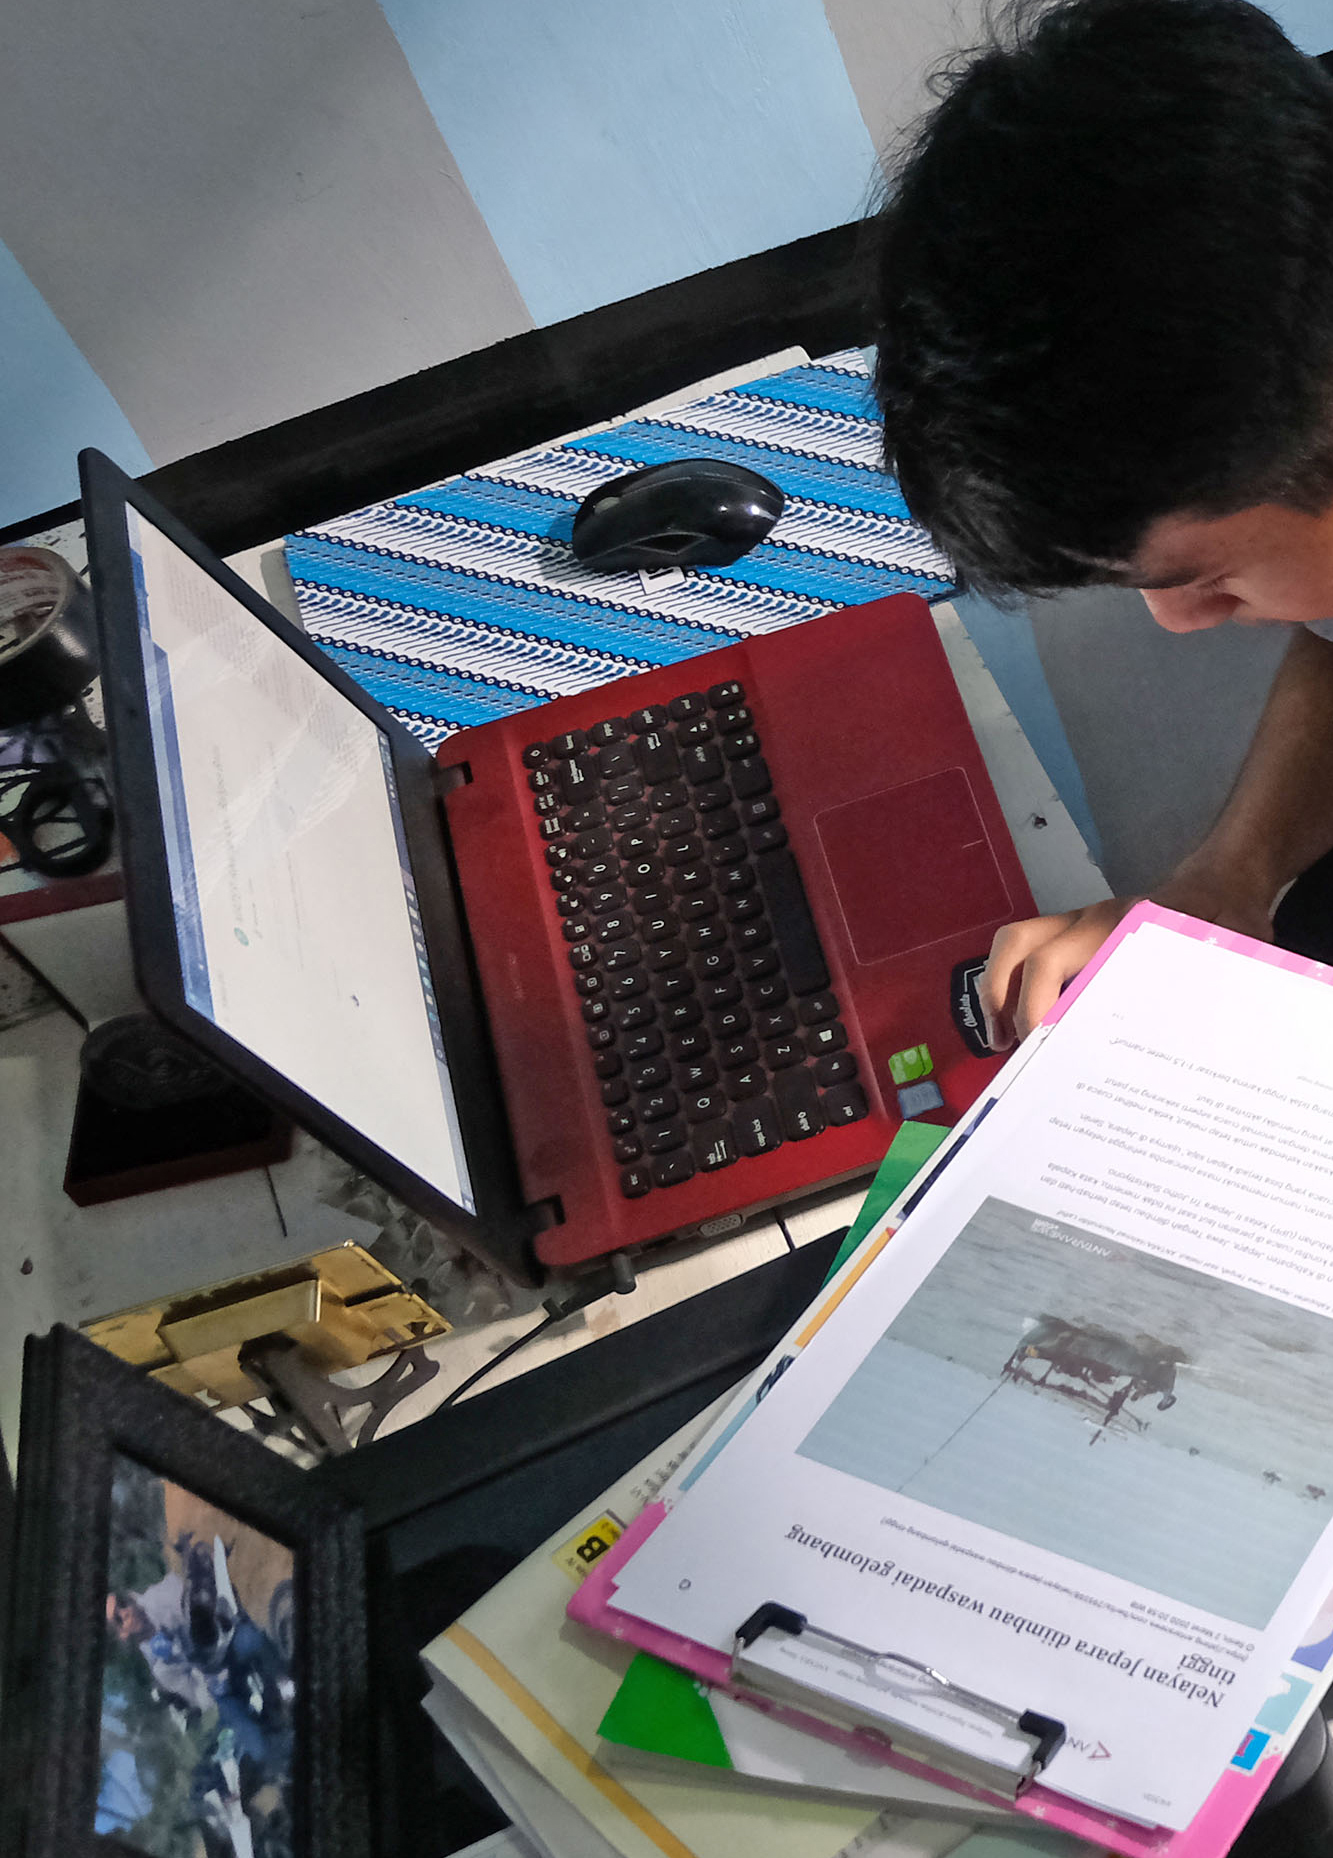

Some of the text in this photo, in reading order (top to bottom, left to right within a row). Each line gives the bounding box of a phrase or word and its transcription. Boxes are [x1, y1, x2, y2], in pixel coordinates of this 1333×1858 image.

[577, 1534, 610, 1563] B
[784, 1524, 895, 1576] gelombang
[891, 1570, 983, 1614] waspadai
[988, 1606, 1071, 1648] diimbau
[1074, 1639, 1143, 1676] Jepara
[1176, 1653, 1235, 1685] tinggi
[1143, 1666, 1224, 1707] Nelayan
